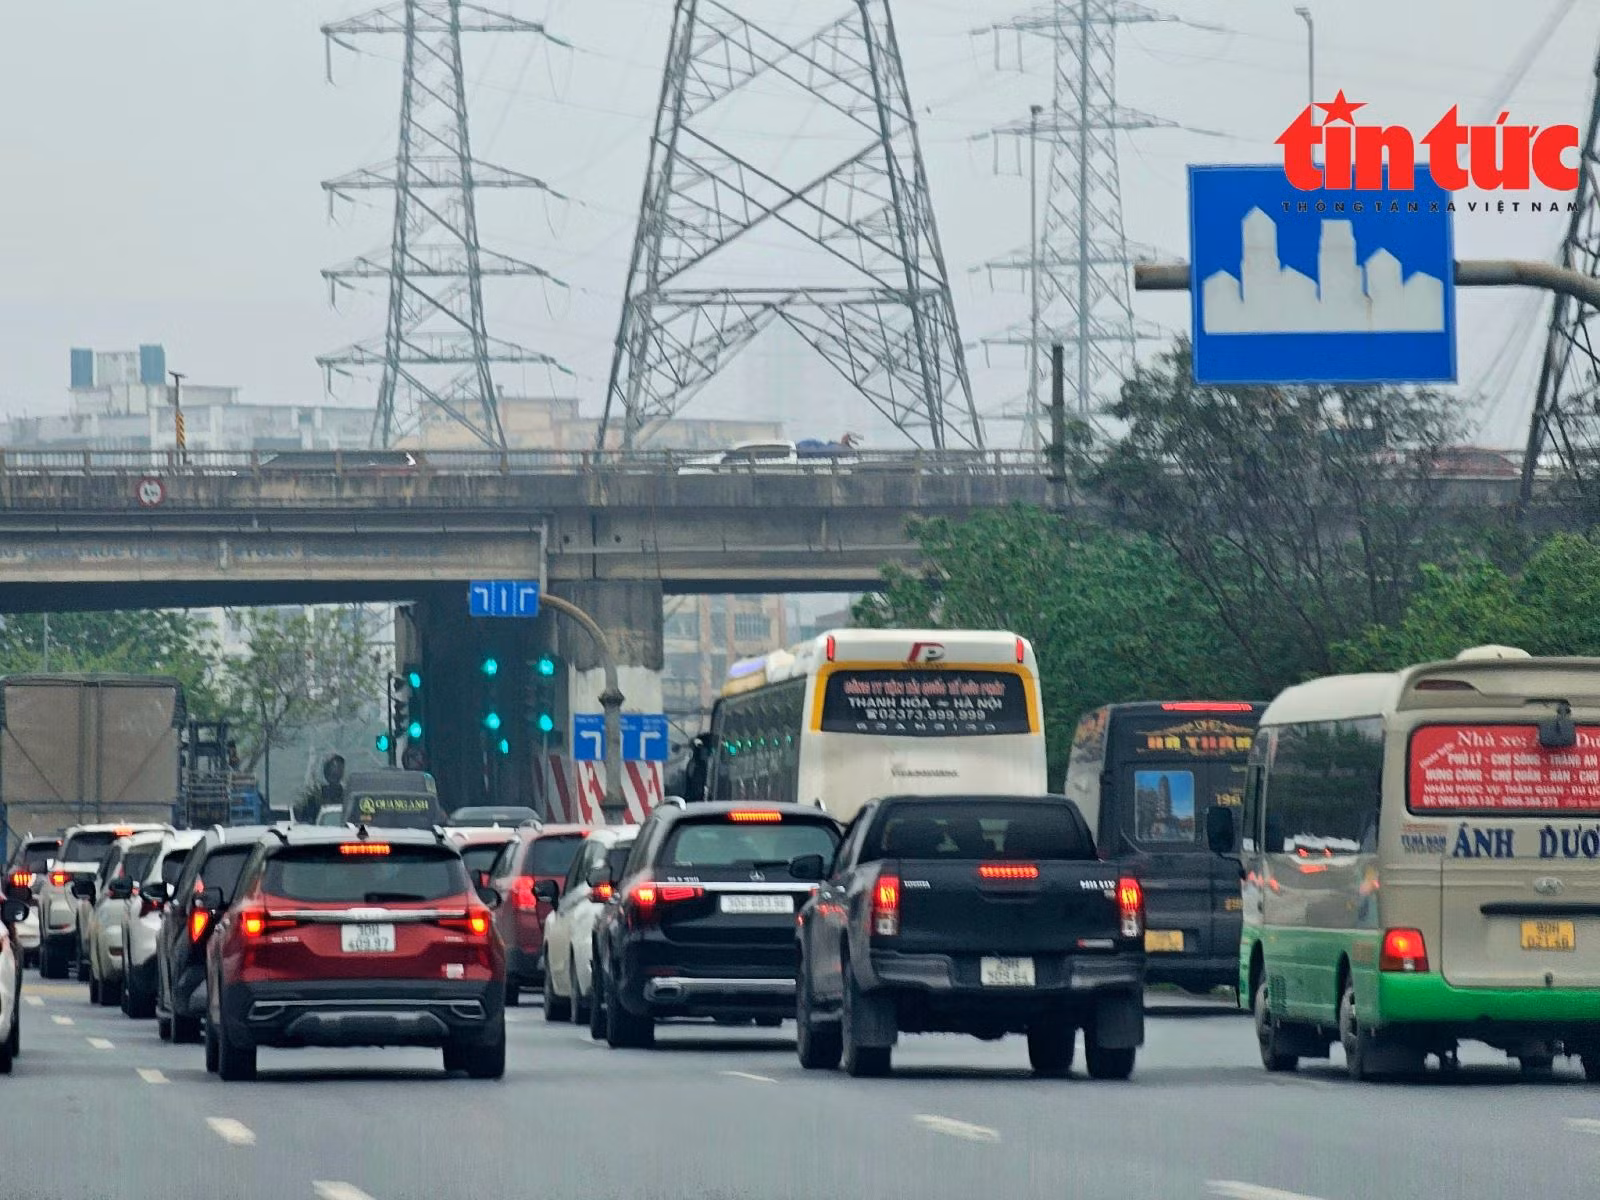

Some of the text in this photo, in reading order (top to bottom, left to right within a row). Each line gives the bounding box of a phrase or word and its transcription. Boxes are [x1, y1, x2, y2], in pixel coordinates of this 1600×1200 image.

[848, 697, 896, 708] THANH
[900, 697, 931, 708] HÓA
[954, 695, 972, 708] HÀ
[977, 696, 1003, 712] NỘI
[879, 709, 986, 721] 02373.999.999
[1457, 730, 1495, 747] Nhà
